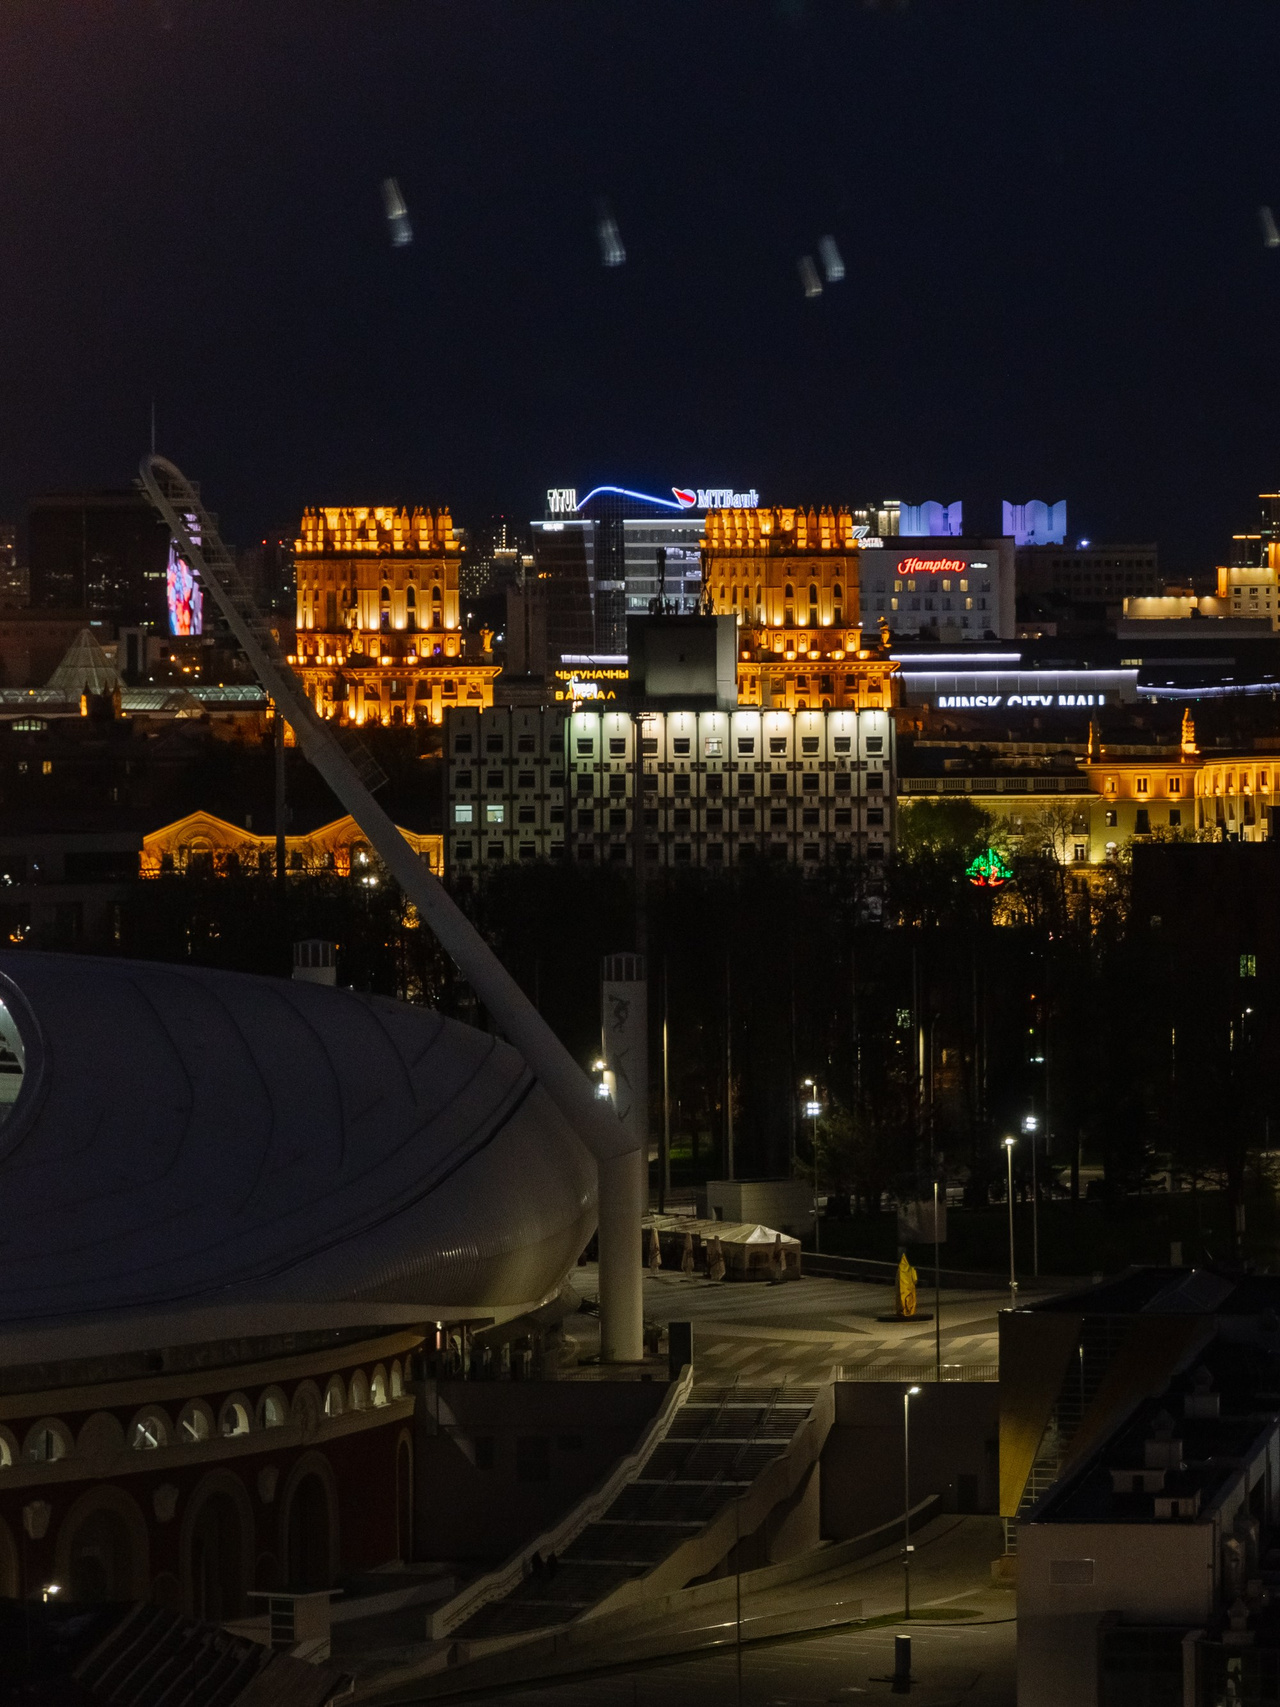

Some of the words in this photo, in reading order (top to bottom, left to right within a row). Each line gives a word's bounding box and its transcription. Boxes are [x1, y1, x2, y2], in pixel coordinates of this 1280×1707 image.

[897, 557, 966, 575] Hampton
[555, 669, 629, 680] ЧЫГУНАЧНЫ
[938, 695, 1002, 708] MINSK
[1007, 695, 1054, 706] CITY
